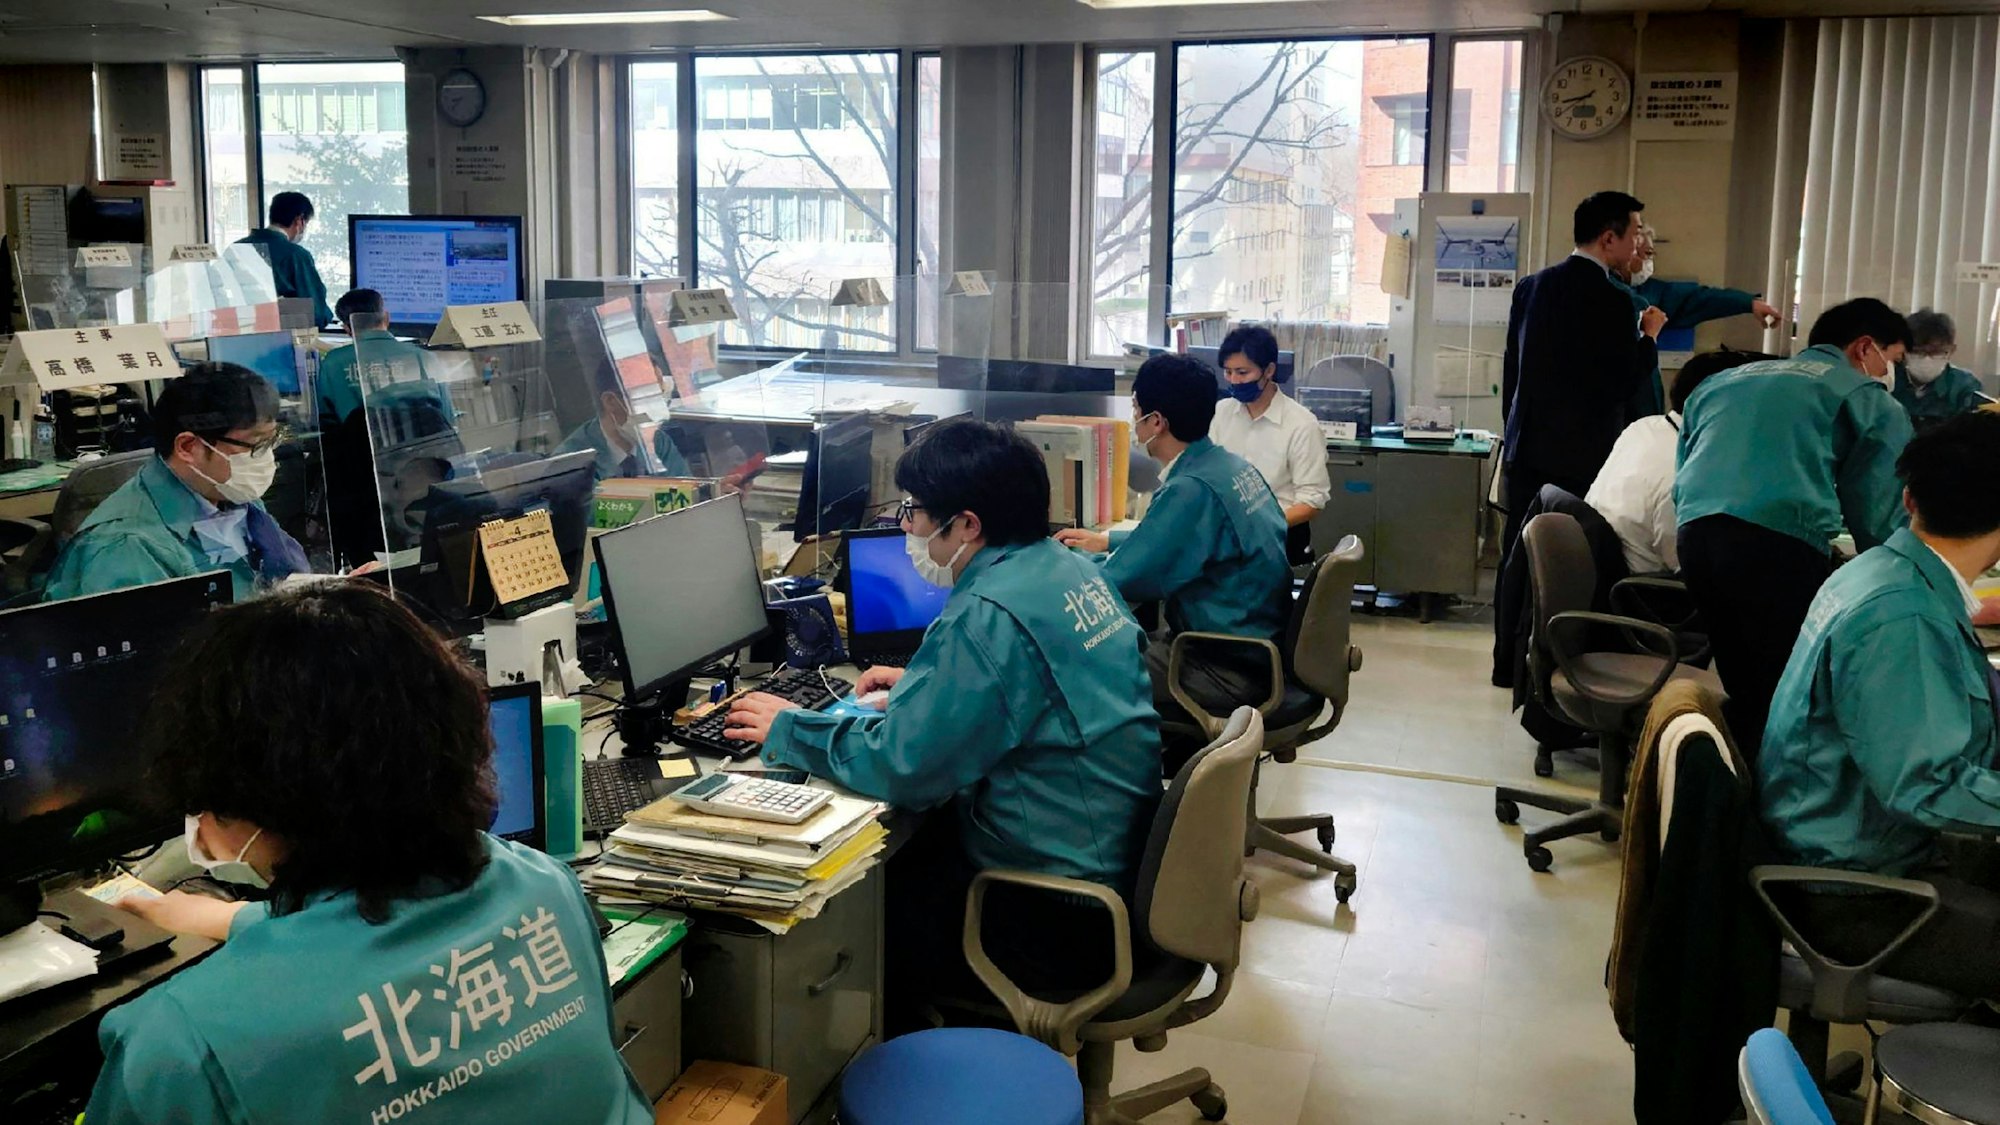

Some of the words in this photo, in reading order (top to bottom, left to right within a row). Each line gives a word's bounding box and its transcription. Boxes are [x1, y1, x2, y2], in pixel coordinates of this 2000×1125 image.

[1568, 69, 1576, 79] 11
[1582, 64, 1592, 75] 12
[1557, 78, 1567, 89] 10
[1608, 77, 1616, 88] 2
[1551, 92, 1559, 103] 9
[1612, 90, 1620, 102] 3
[1605, 105, 1613, 115] 4
[1566, 116, 1573, 127] 7
[1579, 119, 1587, 131] 6
[1594, 116, 1603, 127] 5
[44, 356, 96, 377] 高橋
[117, 351, 164, 370] 葉月
[597, 501, 634, 512] よくわかる
[514, 525, 521, 536] 4
[342, 906, 579, 1085] 北海道
[370, 1058, 484, 1125] HOKKAIDO
[485, 994, 587, 1067] GOVERNMENT
